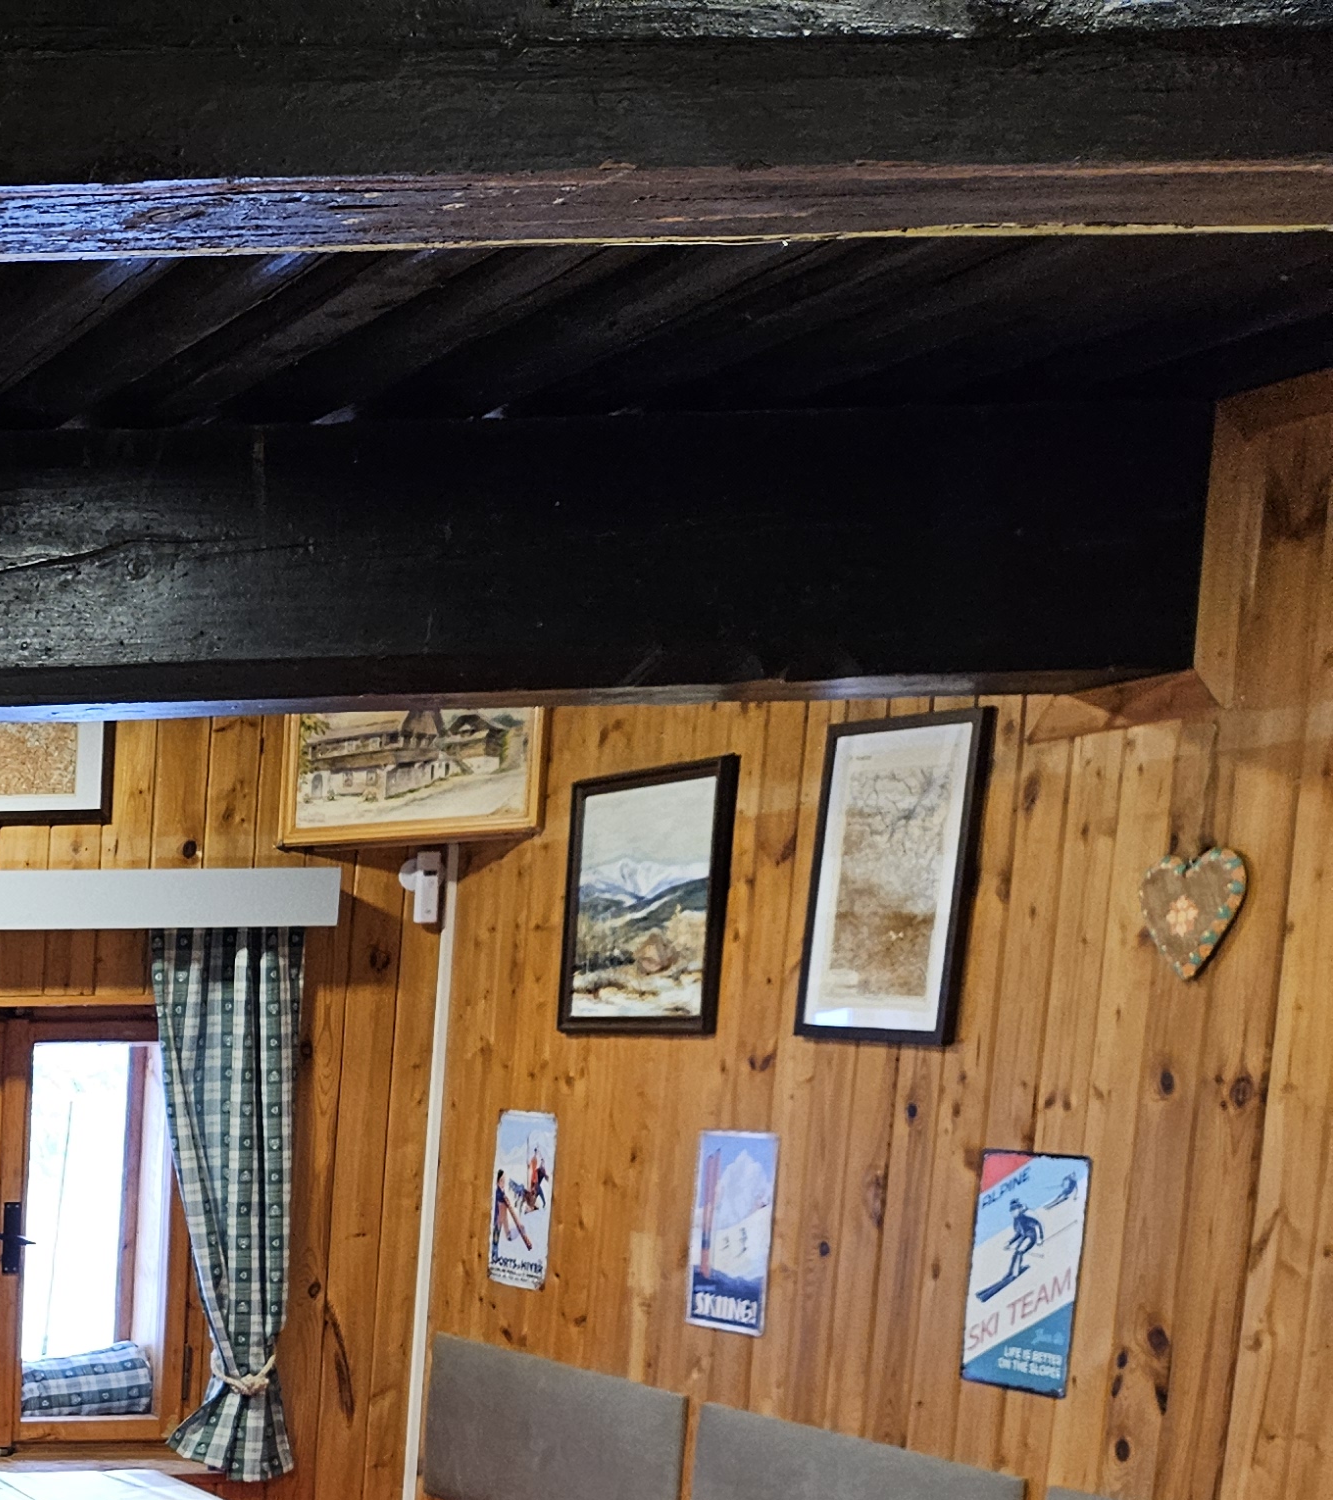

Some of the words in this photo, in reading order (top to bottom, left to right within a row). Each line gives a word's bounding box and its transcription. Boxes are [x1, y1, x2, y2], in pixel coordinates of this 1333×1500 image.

[981, 1165, 1032, 1210] ALPINE
[694, 1292, 757, 1325] SKIING!
[967, 1310, 1000, 1352] SKI
[1006, 1266, 1073, 1326] TEAM
[997, 1356, 1012, 1370] ON
[1012, 1359, 1028, 1374] THE
[1004, 1345, 1022, 1361] LIFE
[1032, 1350, 1063, 1367] BETTER
